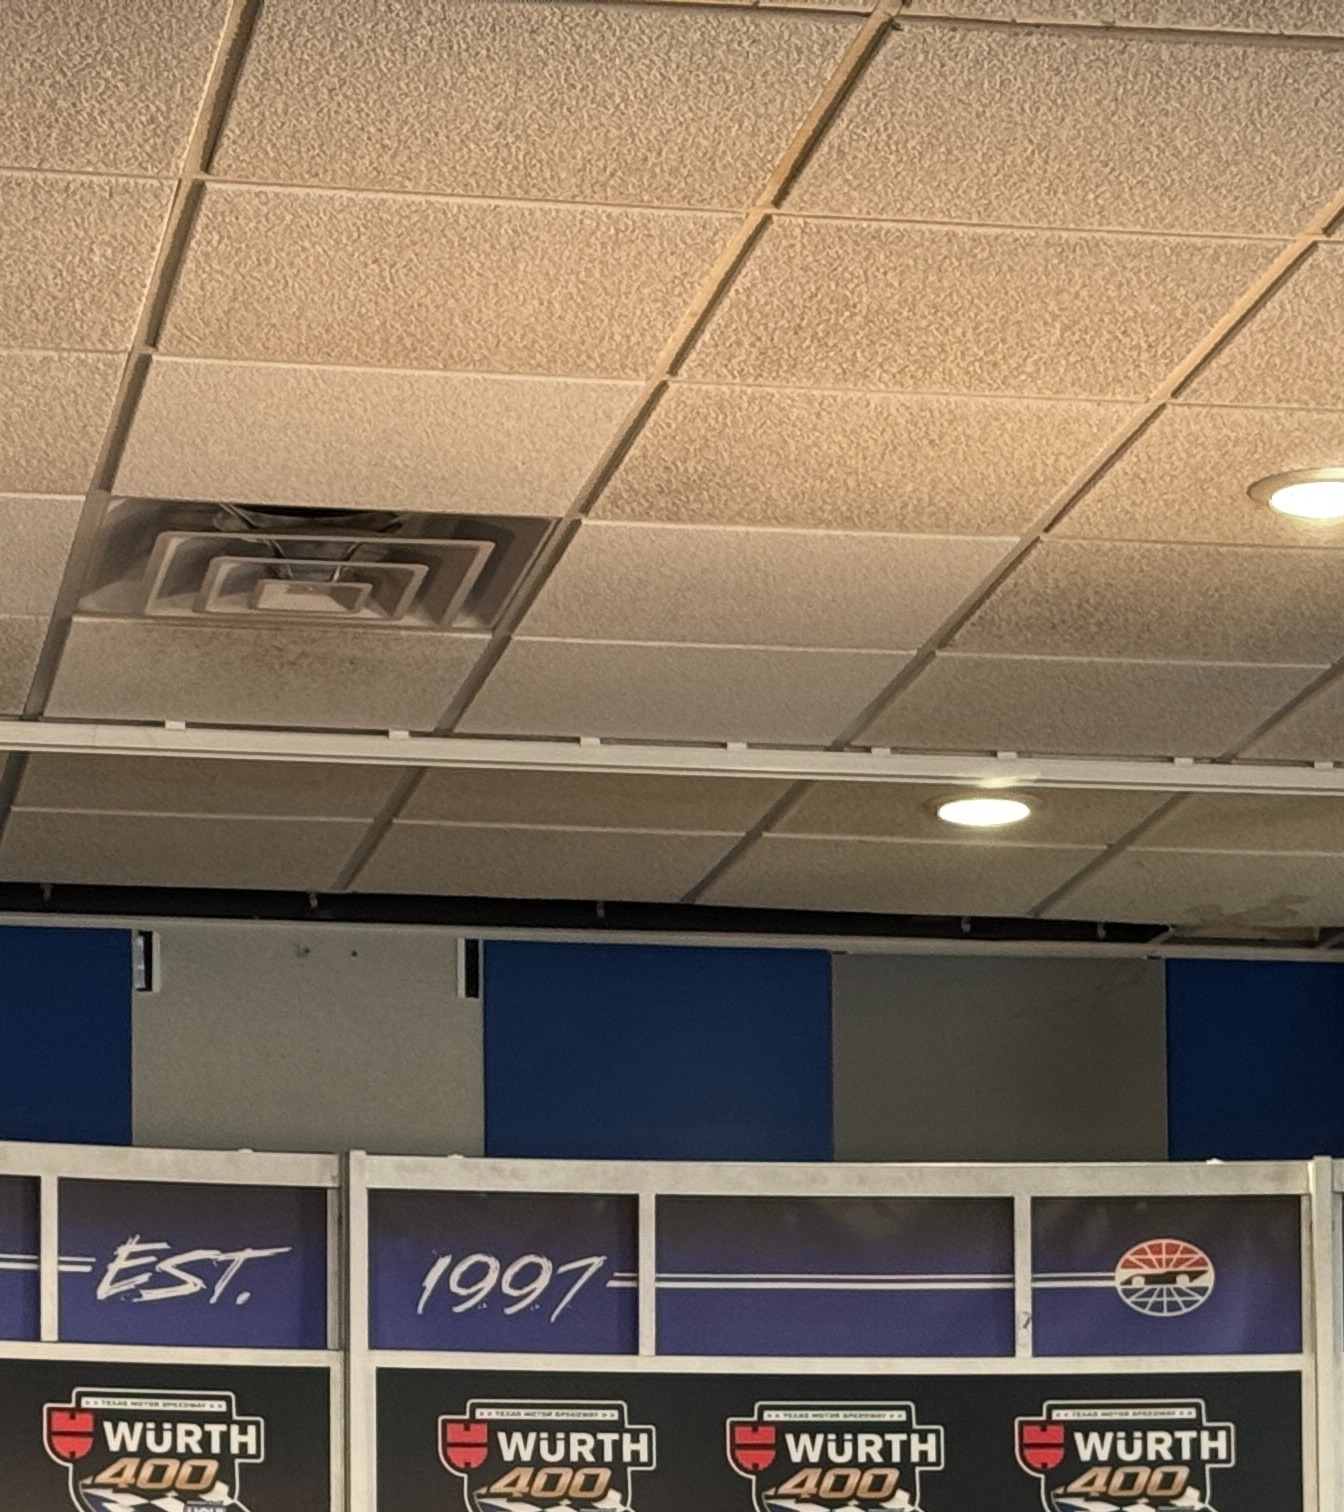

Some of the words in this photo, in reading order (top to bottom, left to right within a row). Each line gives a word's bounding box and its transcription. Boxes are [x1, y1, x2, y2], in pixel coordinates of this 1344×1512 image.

[96, 1233, 292, 1305] EST.
[416, 1252, 608, 1323] 1997
[103, 1420, 256, 1455] WÜRTH
[497, 1431, 648, 1462] WÜRTH
[785, 1433, 937, 1463] WÜRTH
[1073, 1430, 1227, 1461] WÜRTH
[94, 1457, 219, 1490] 400
[489, 1466, 612, 1499] 400
[777, 1467, 900, 1499] 400
[1066, 1465, 1190, 1497] 400
